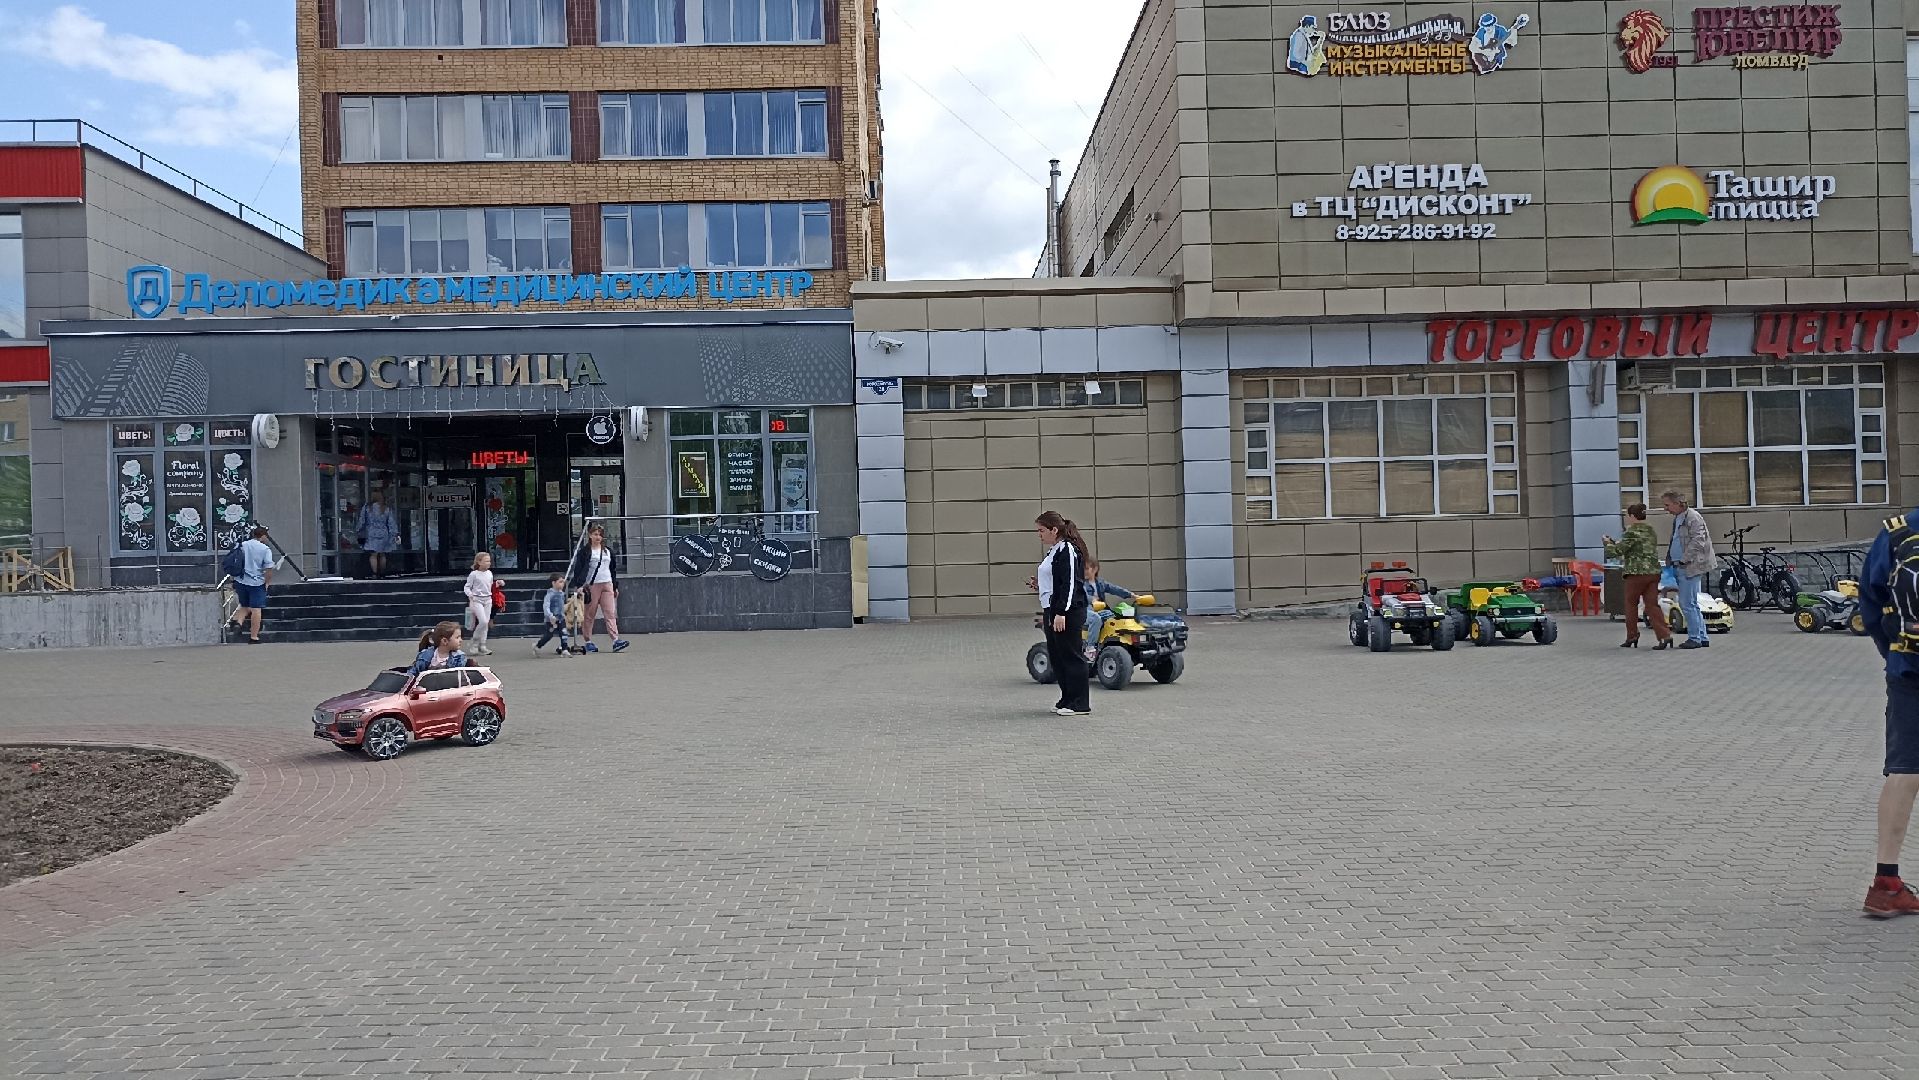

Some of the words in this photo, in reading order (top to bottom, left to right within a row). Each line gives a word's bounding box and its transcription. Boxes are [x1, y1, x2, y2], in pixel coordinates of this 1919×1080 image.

[1328, 12, 1391, 31] БЛЮЗ
[1695, 5, 1842, 28] ПРЕСТИЖ
[1327, 42, 1468, 59] МУЗЫКАЛЬНЫЕ
[1696, 28, 1843, 59] ЮВЕЛИР
[1329, 59, 1467, 75] ИНСТРУМЕНТЫ
[1735, 54, 1809, 69] ЛОМБАРД
[1349, 164, 1489, 191] АРЕНДА
[1708, 170, 1836, 203] Ташир
[1315, 196, 1357, 220] ТЦ
[1708, 200, 1820, 220] пицца
[1336, 223, 1497, 240] 8-925-286-91-92
[178, 273, 441, 314] Деломедика
[445, 265, 698, 308] МЕДИЦИНСКИЙ
[708, 270, 813, 303] ЦЕНТР
[1754, 309, 1919, 359] ЦЕНТР
[304, 352, 606, 392] ГОСТИНИЦА
[118, 431, 151, 440] ЦВЕТЫ
[214, 429, 246, 438] ЦВЕТЫ
[171, 460, 200, 470] Floral
[472, 451, 528, 467] ЦВЕТЫ
[166, 471, 204, 479] company
[436, 494, 470, 503] ЦВЕТЫ
